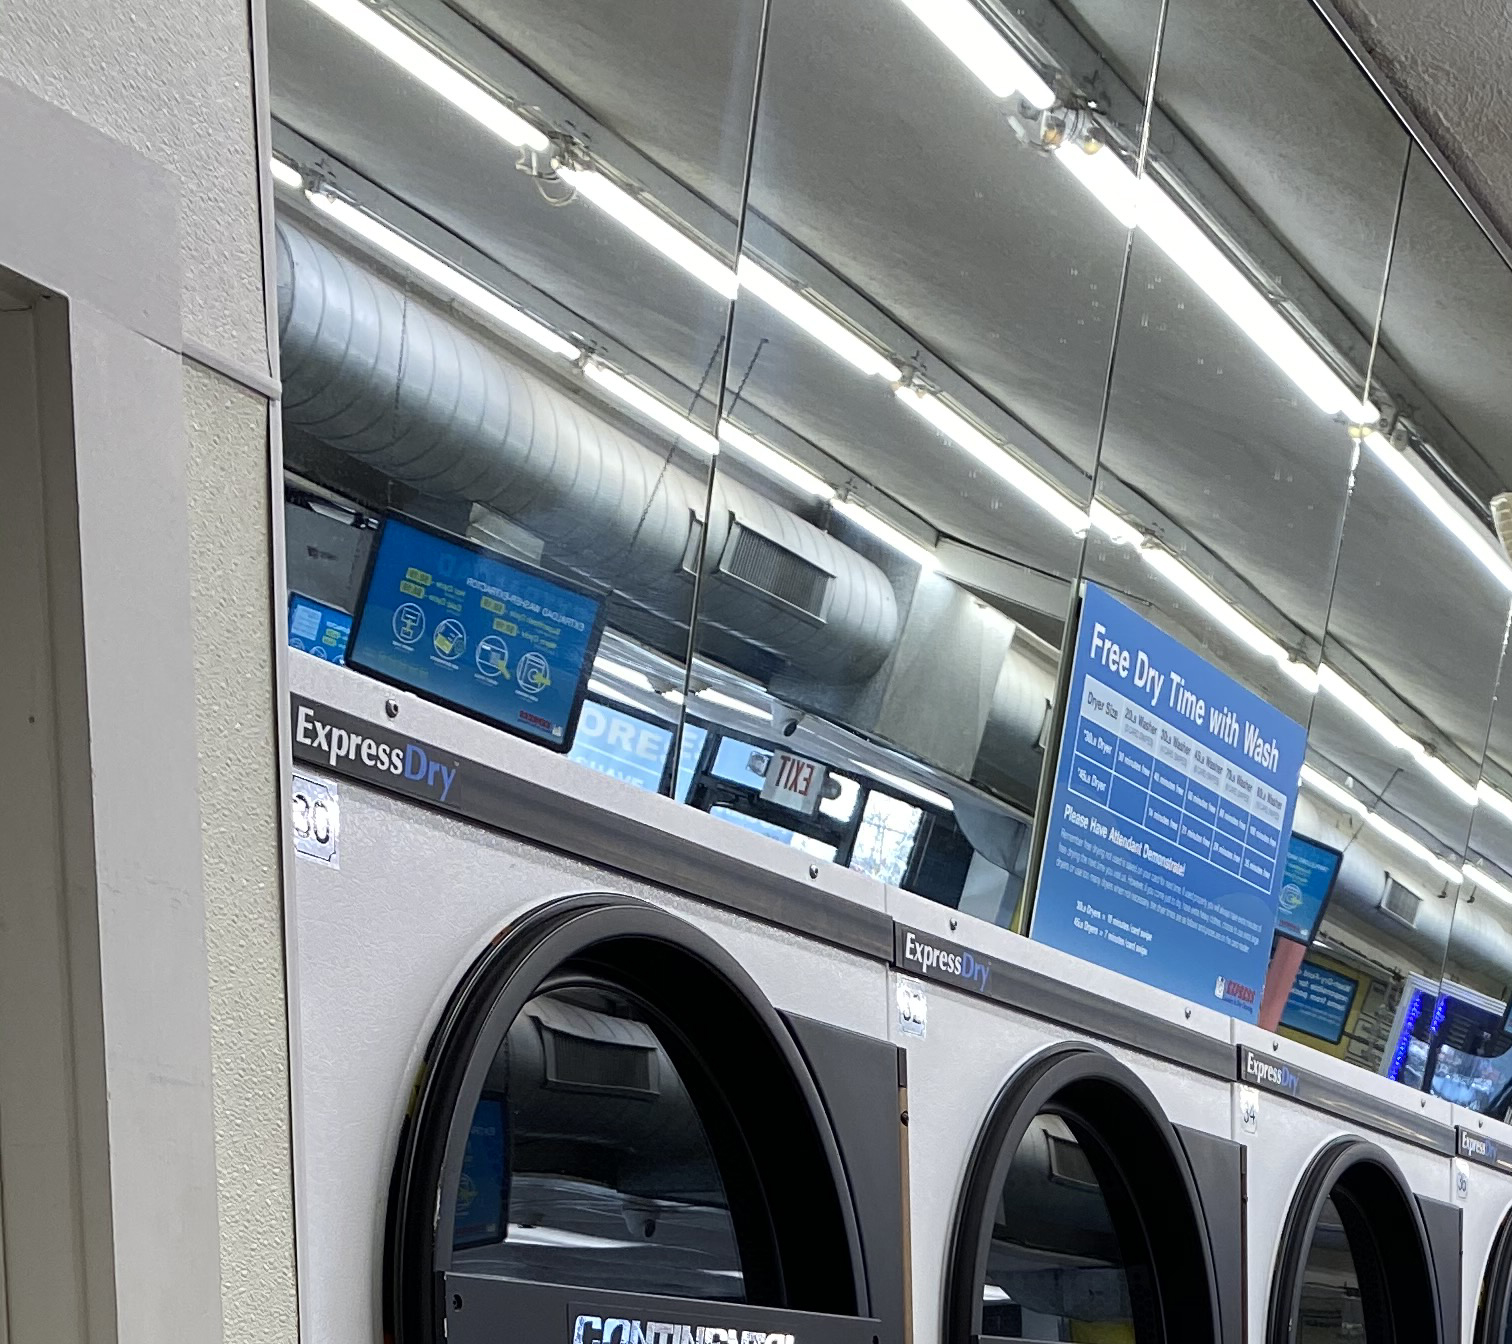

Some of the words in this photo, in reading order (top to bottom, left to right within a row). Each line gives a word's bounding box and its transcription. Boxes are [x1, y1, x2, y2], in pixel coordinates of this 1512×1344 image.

[1086, 690, 1105, 715] Dryer
[1105, 700, 1119, 720] Size
[1088, 619, 1133, 680] Free
[1131, 648, 1166, 711] Dry
[1165, 669, 1207, 727] Time
[1207, 697, 1241, 749] with
[1241, 720, 1281, 774] Wash
[296, 705, 456, 802] ExpressDry
[1063, 802, 1089, 830] Please
[1089, 815, 1108, 839] Have
[1107, 825, 1142, 856] Attendant
[905, 932, 990, 993] ExpressDry
[1246, 1051, 1299, 1097] ExpressDry
